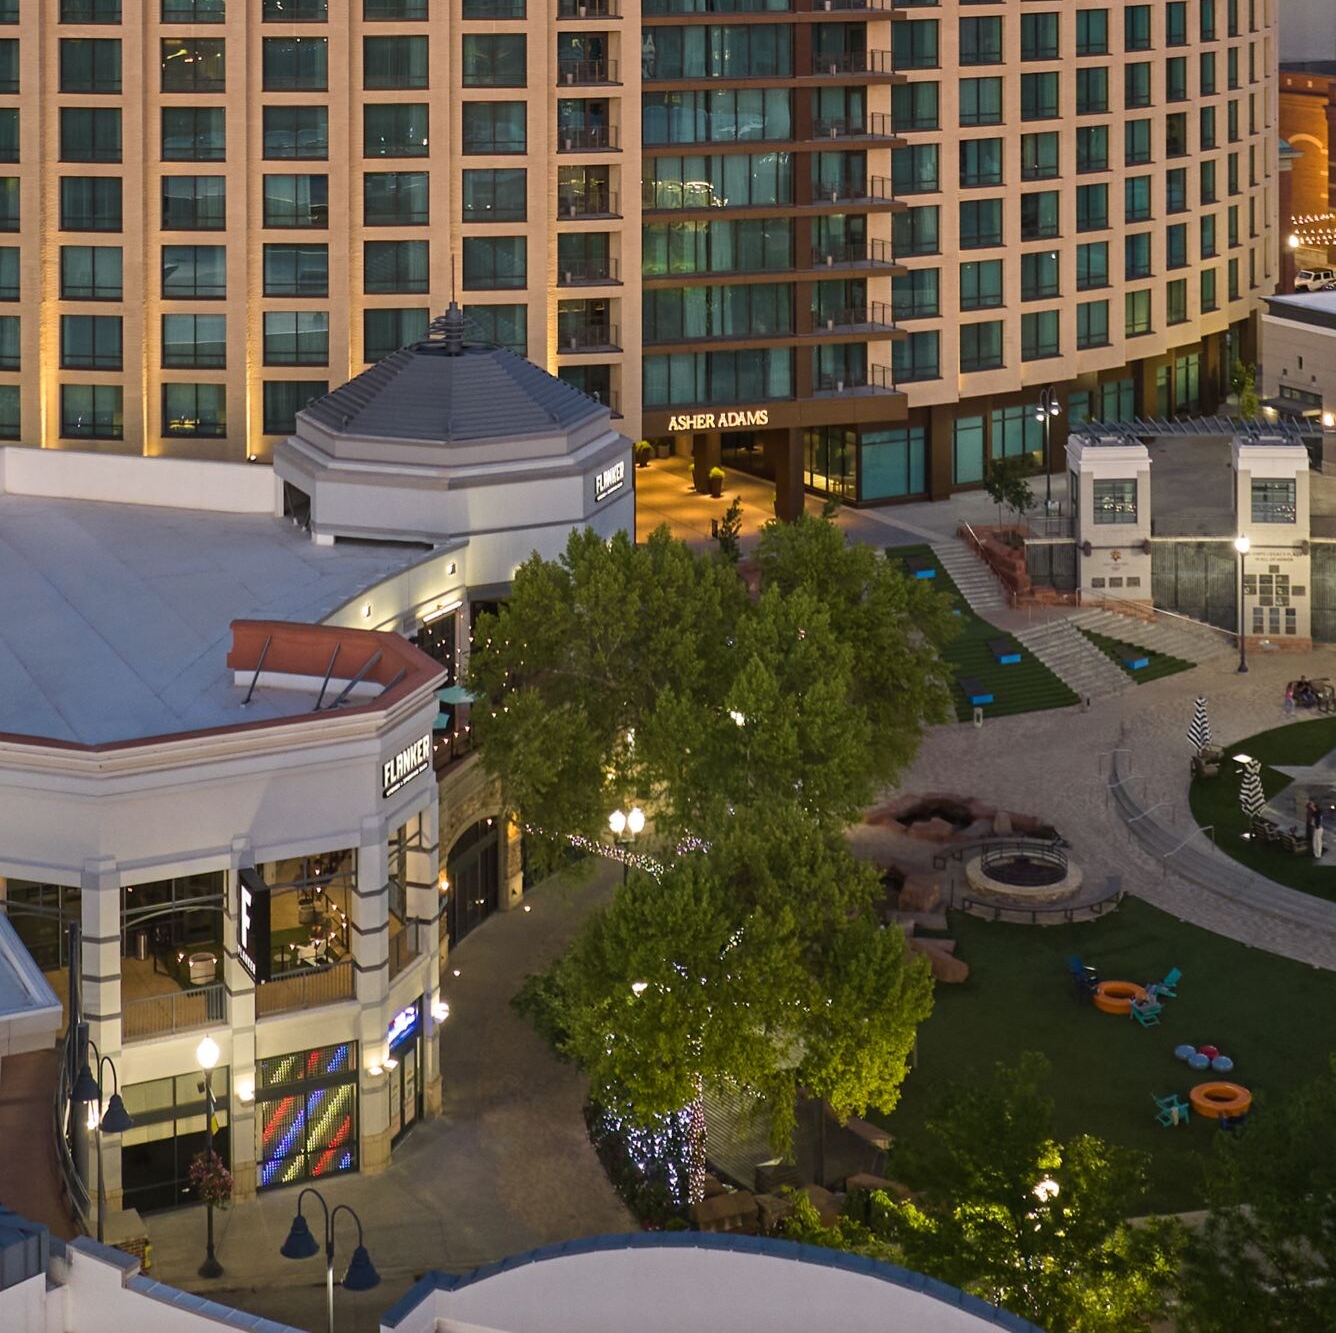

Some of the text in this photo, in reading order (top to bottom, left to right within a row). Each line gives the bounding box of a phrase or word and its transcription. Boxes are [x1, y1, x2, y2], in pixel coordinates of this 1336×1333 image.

[668, 409, 769, 431] ASHER ADAMS
[595, 460, 625, 495] FLANKER
[384, 734, 430, 788] FLANKER
[241, 885, 252, 949] F
